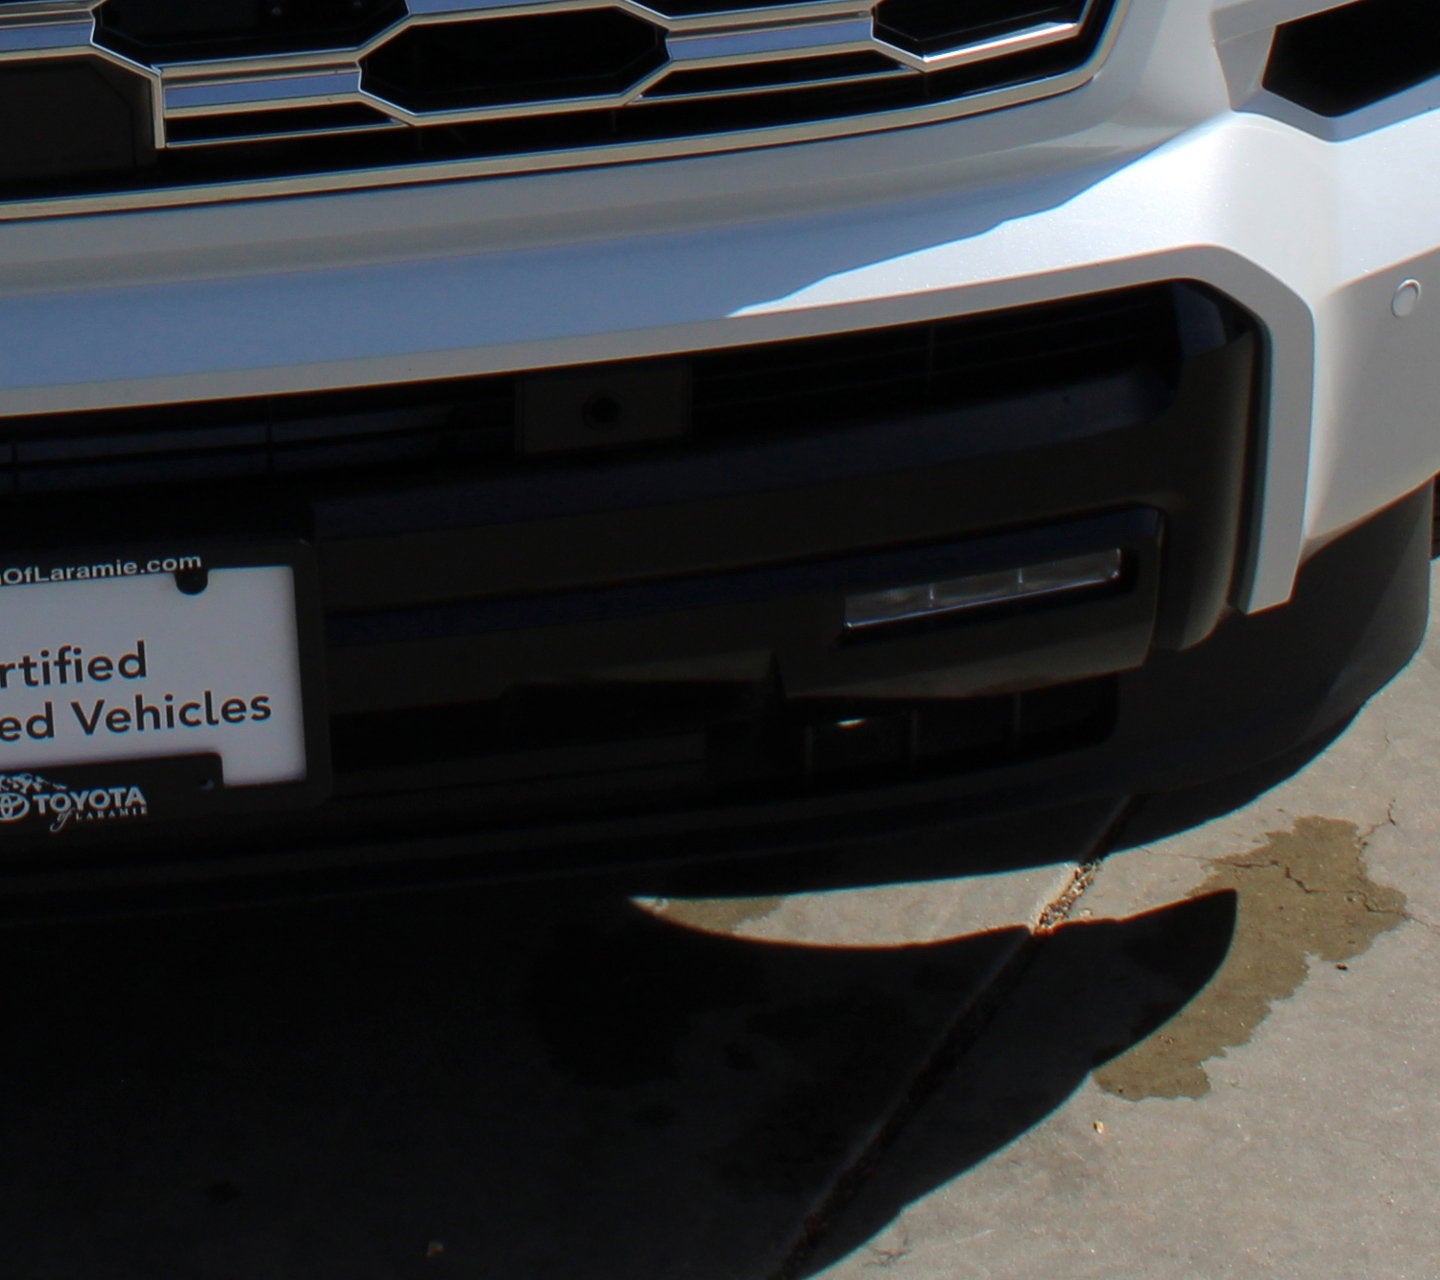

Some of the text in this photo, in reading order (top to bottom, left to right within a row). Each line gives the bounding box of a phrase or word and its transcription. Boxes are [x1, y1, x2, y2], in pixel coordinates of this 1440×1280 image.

[71, 691, 272, 737] Vehicles
[32, 786, 147, 815] TOYOTA
[76, 806, 148, 821] LARAMIE
